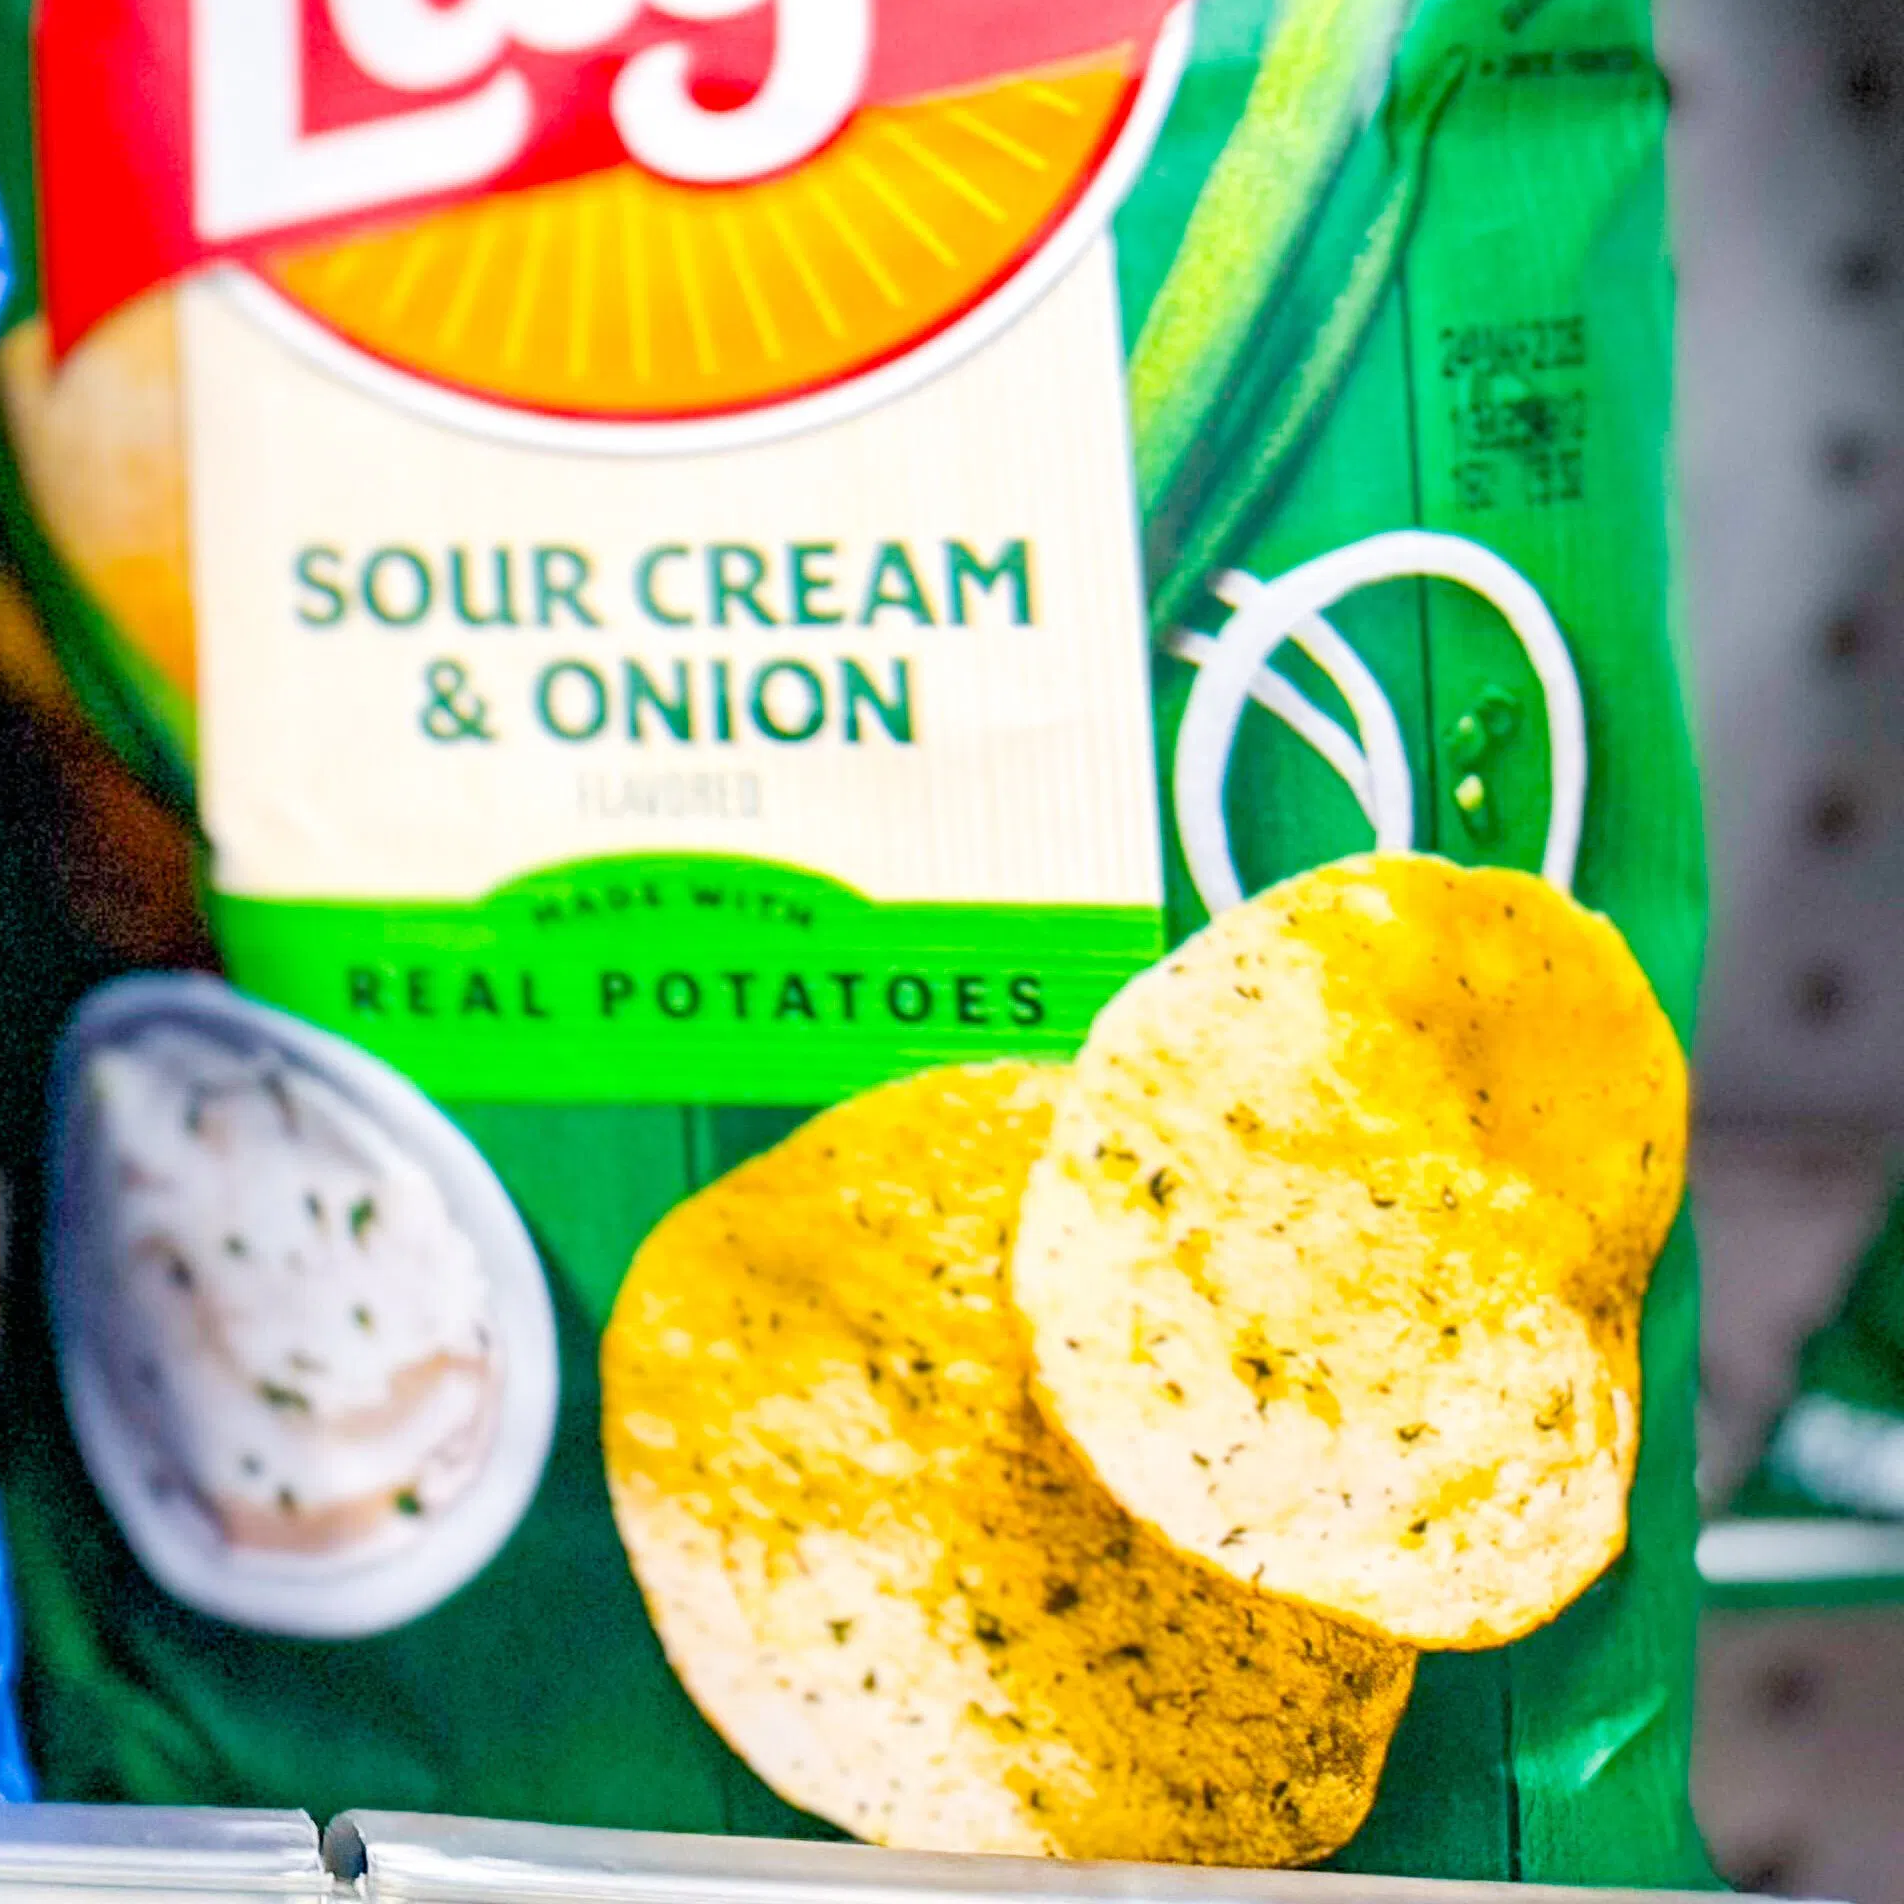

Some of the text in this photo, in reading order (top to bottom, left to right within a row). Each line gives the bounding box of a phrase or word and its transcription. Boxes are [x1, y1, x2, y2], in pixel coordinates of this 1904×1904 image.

[295, 538, 1038, 630] SOUR CREAM
[419, 657, 919, 746] & ONION
[348, 965, 1048, 1029] REAL POTATOES
